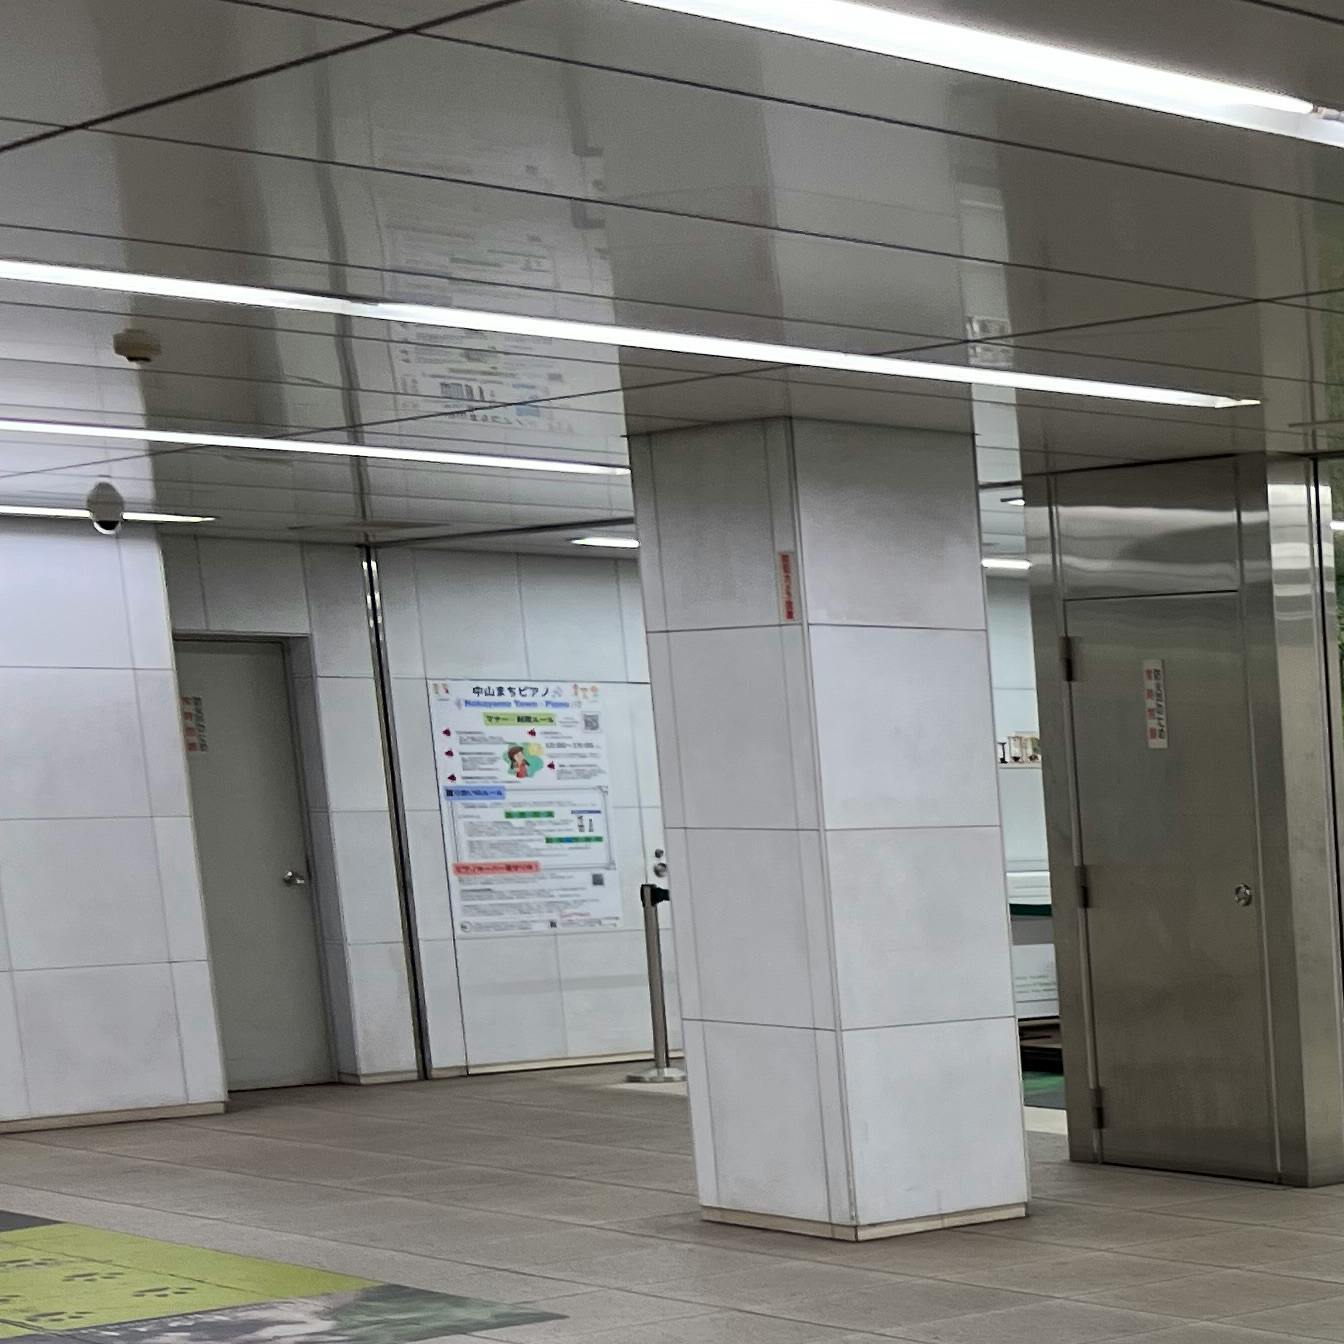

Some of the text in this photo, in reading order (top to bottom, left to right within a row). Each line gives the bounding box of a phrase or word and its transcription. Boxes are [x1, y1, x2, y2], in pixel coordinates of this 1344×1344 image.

[472, 686, 549, 697] 中山まちピアノ
